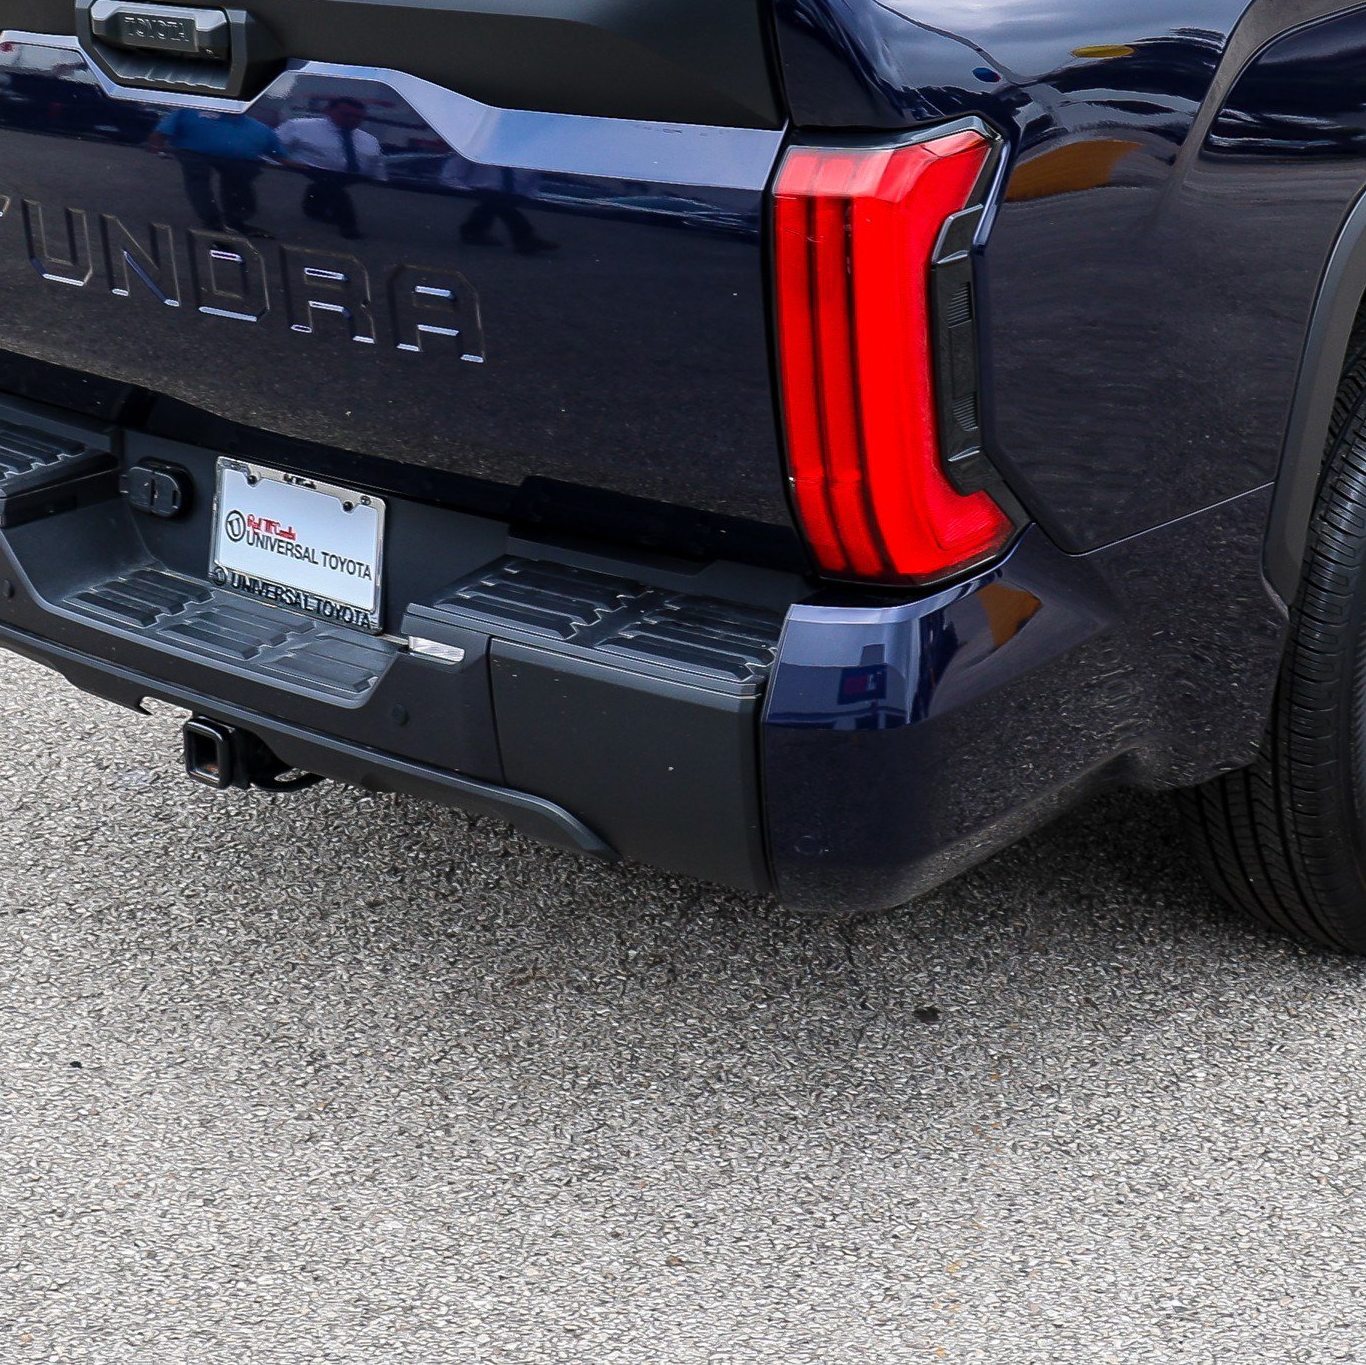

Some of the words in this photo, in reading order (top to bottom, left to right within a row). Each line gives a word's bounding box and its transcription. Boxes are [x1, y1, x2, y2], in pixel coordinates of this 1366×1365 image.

[123, 15, 191, 43] TOYOTA
[246, 529, 319, 565] UNIVERSAL
[321, 551, 373, 581] TOYOTA
[232, 571, 312, 612] UNIVERSAL
[313, 596, 372, 630] TOYOTA
